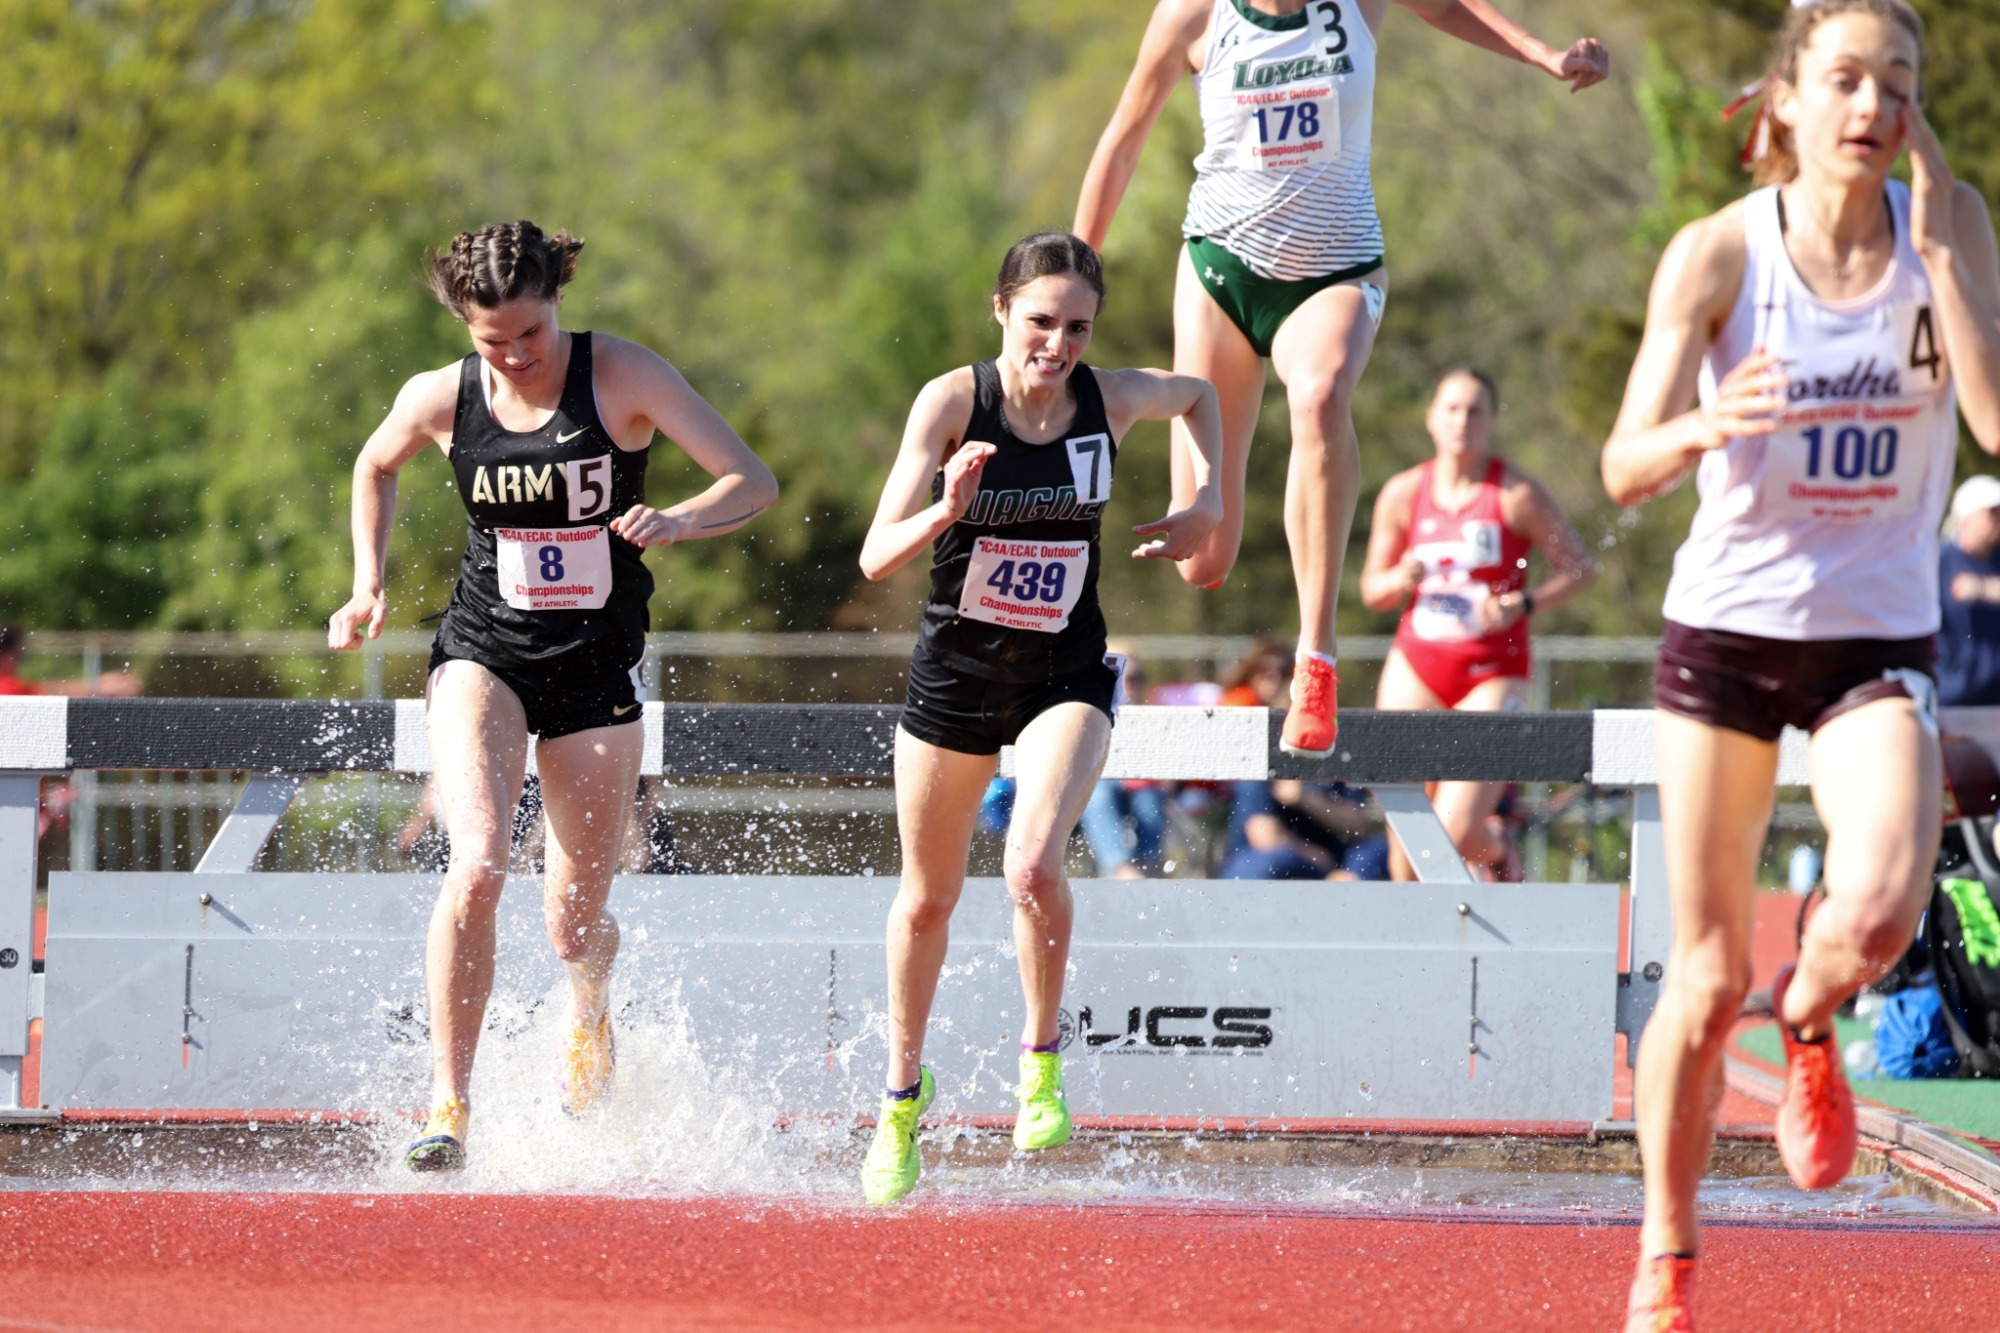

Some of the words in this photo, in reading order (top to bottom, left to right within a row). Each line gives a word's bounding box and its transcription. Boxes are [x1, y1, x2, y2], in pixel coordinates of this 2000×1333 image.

[1317, 1, 1348, 55] 3
[1233, 54, 1354, 90] LOYOLA
[1289, 88, 1330, 101] Outdoor
[1252, 101, 1320, 143] 178
[1252, 141, 1324, 157] Championships
[1910, 306, 1941, 381] 4
[1075, 438, 1102, 501] 7
[1801, 425, 1900, 481] 100
[579, 460, 605, 517] 5
[556, 529, 600, 542] Outdoor
[980, 541, 1038, 558] IC4A/ECAC
[1040, 546, 1081, 558] Outdoor
[538, 545, 565, 582] 8
[987, 559, 1067, 603] 439
[516, 584, 594, 597] Championships
[544, 600, 578, 608] ATHLETIC
[980, 596, 1063, 619] Championships
[1007, 618, 1042, 629] ATHLETIC
[1, 950, 17, 963] 30
[1080, 1006, 1273, 1048] UCS
